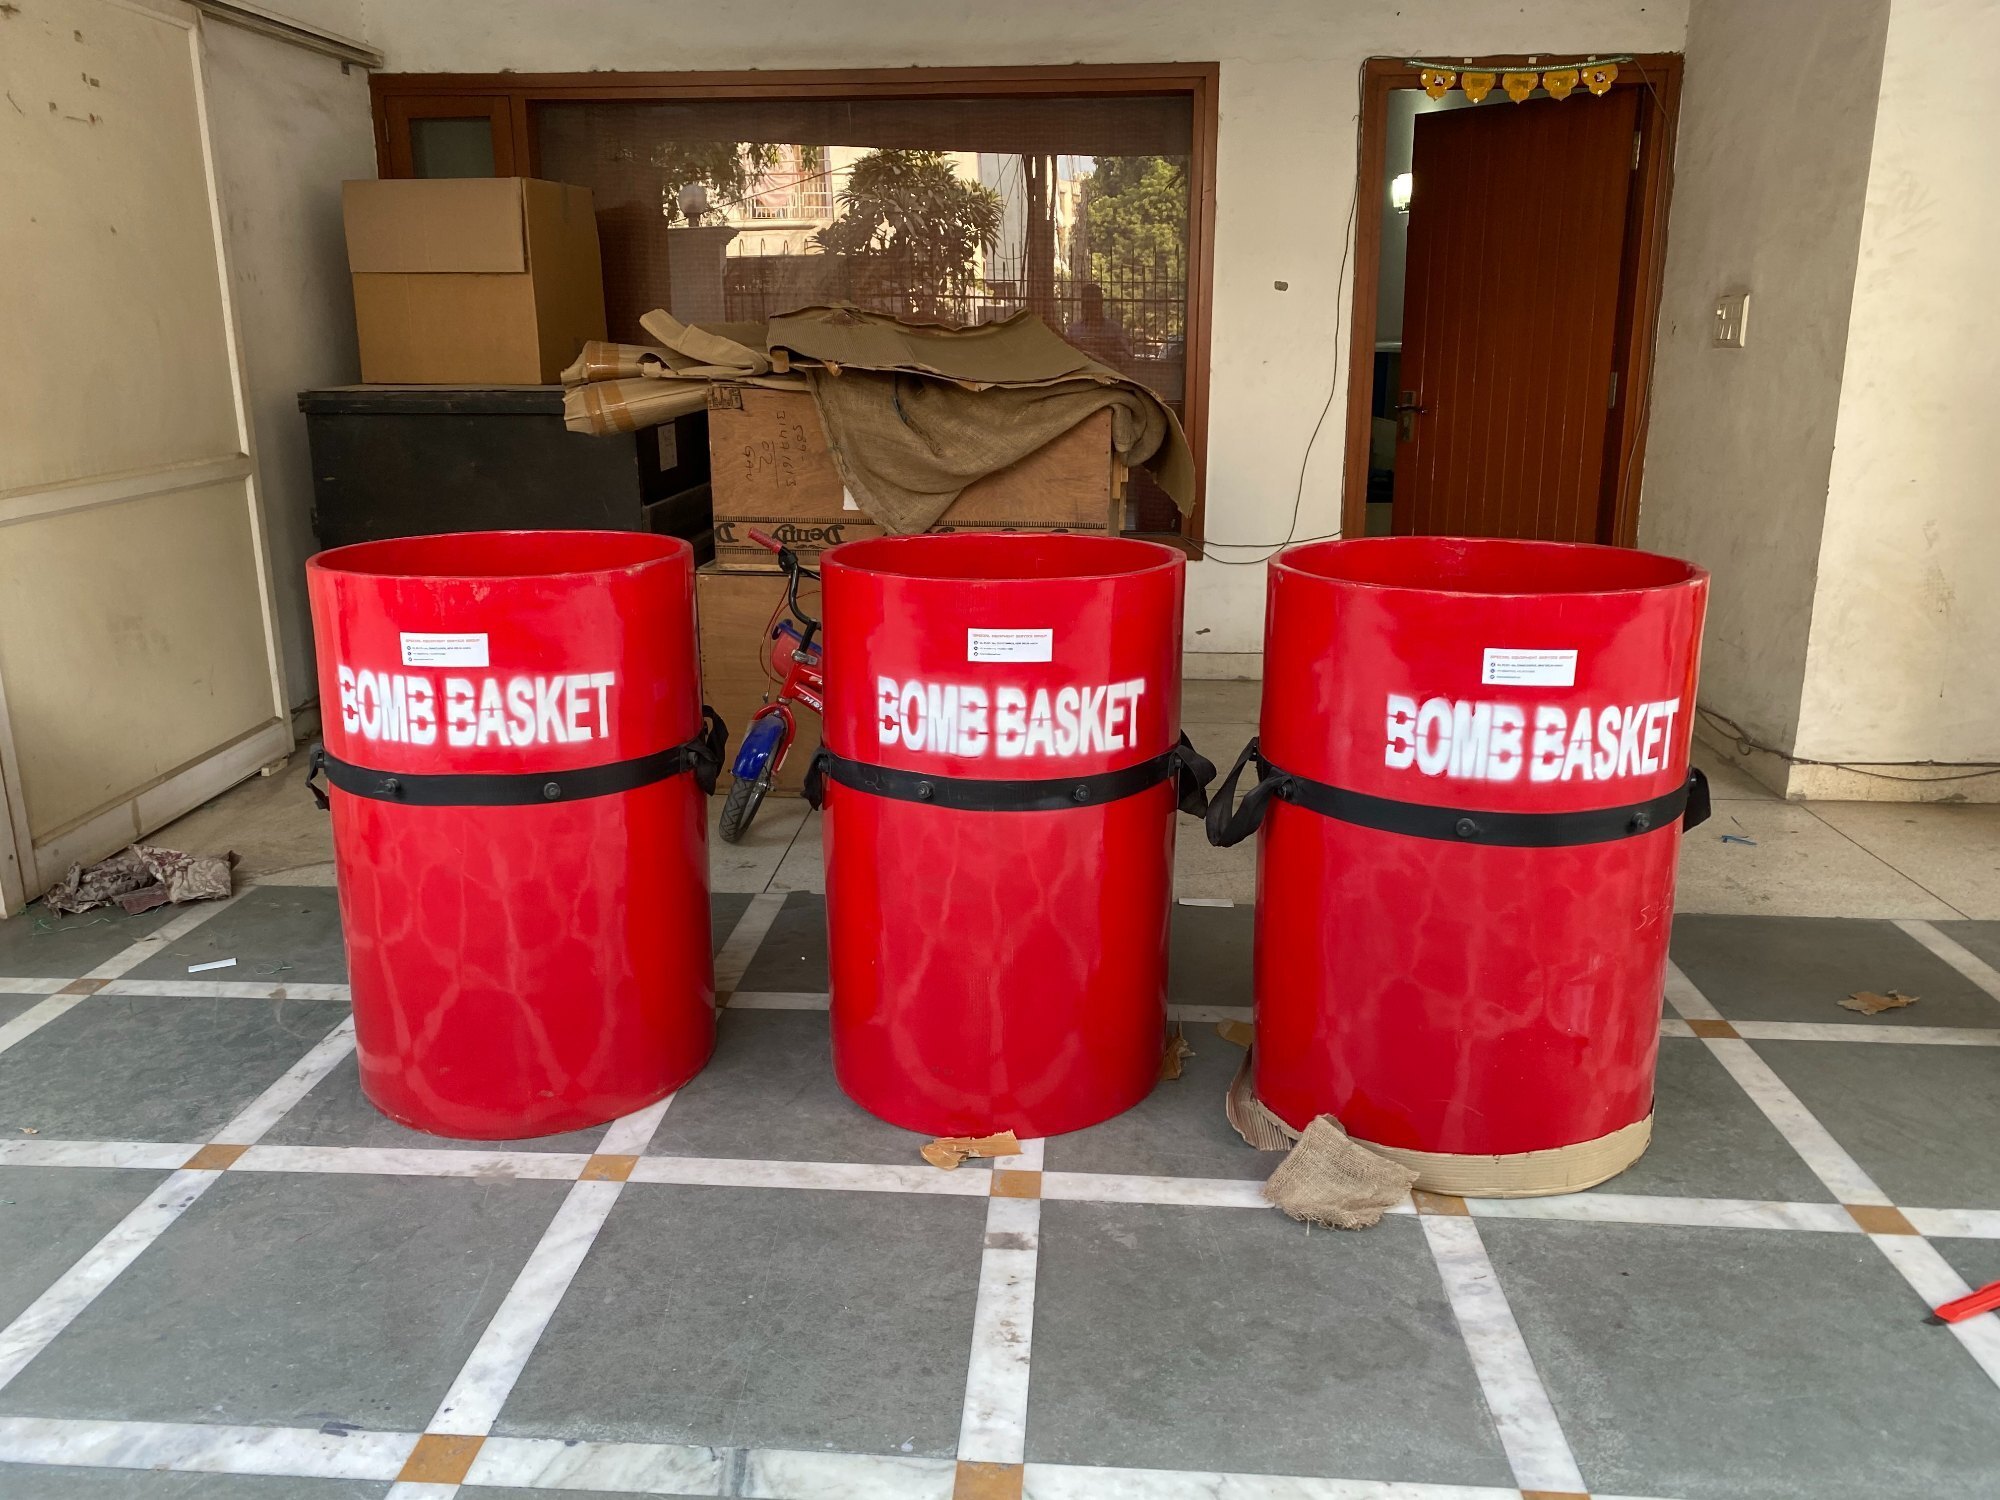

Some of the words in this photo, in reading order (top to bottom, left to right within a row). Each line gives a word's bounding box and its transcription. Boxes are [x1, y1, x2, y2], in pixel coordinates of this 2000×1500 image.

[338, 664, 437, 745] BOMB
[445, 671, 615, 747] BASKET
[878, 675, 989, 758] BOMB
[996, 678, 1145, 758] BASKET
[1385, 693, 1525, 781] BOMB
[1530, 697, 1679, 781] BASKET
